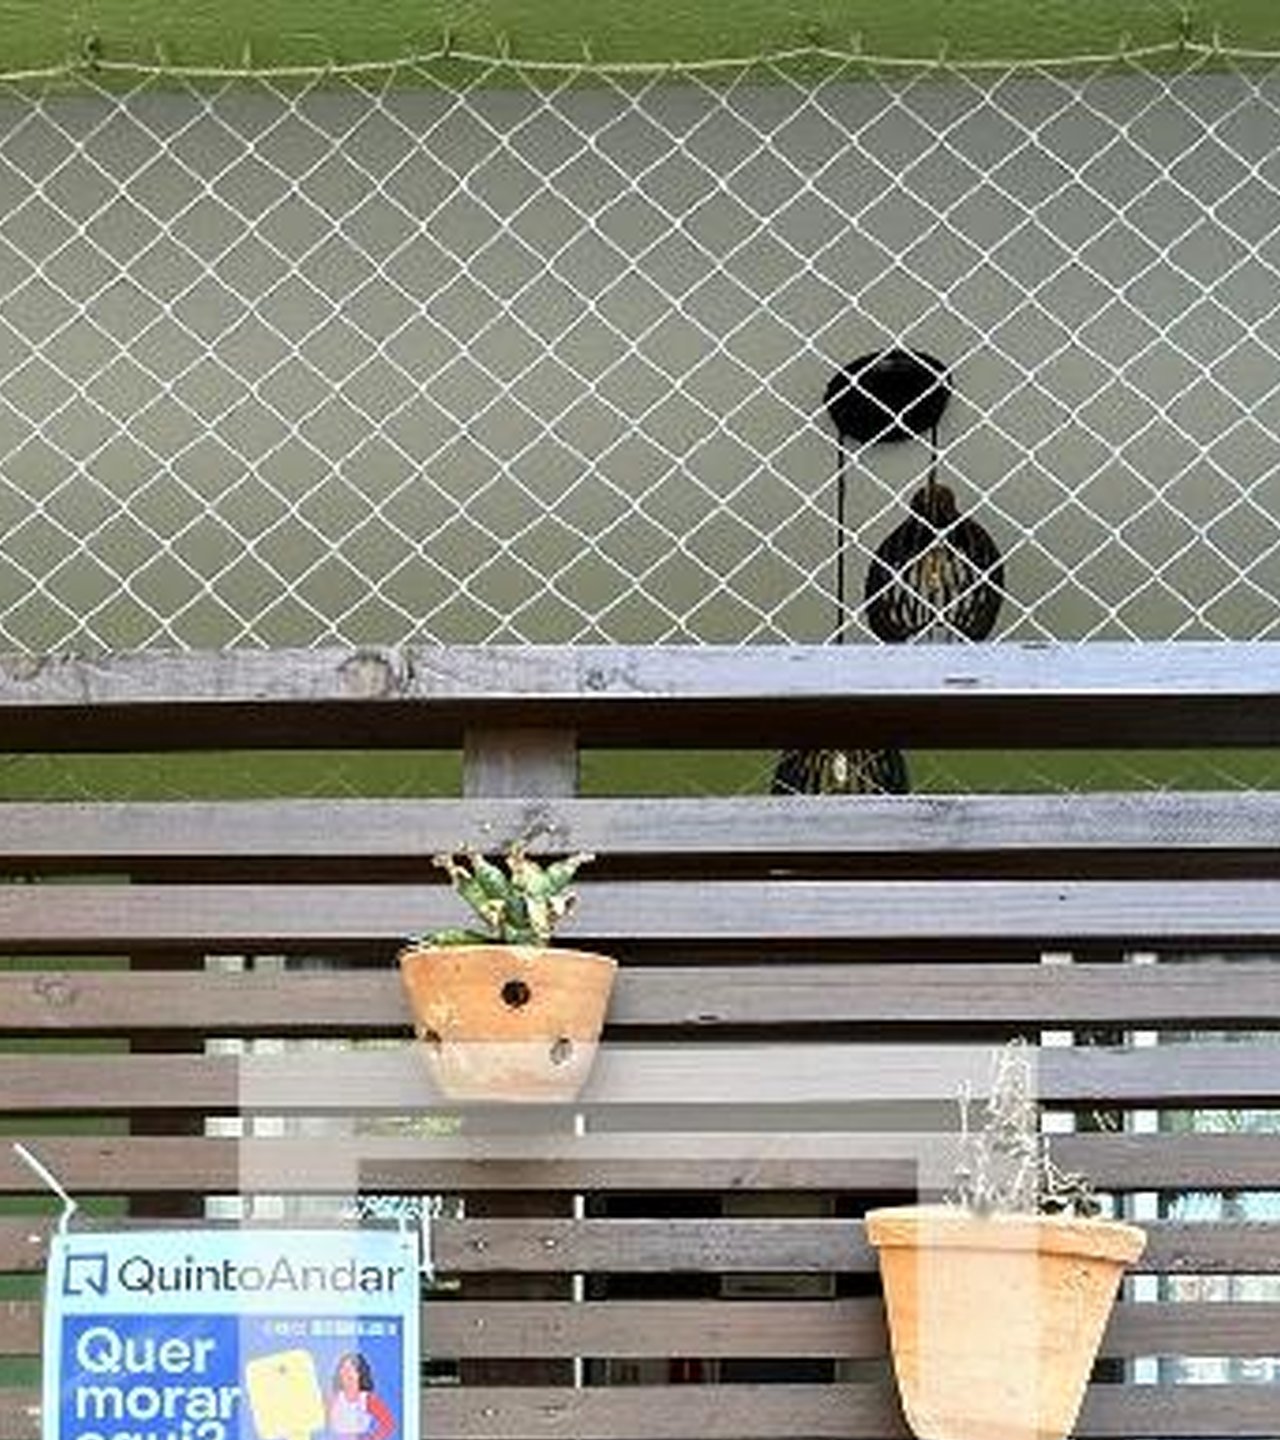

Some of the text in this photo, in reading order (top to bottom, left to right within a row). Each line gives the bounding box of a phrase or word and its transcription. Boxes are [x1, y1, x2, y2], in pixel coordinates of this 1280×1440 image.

[119, 1254, 404, 1294] QuintoAndar
[76, 1327, 215, 1377] Quer
[76, 1385, 241, 1420] morar
